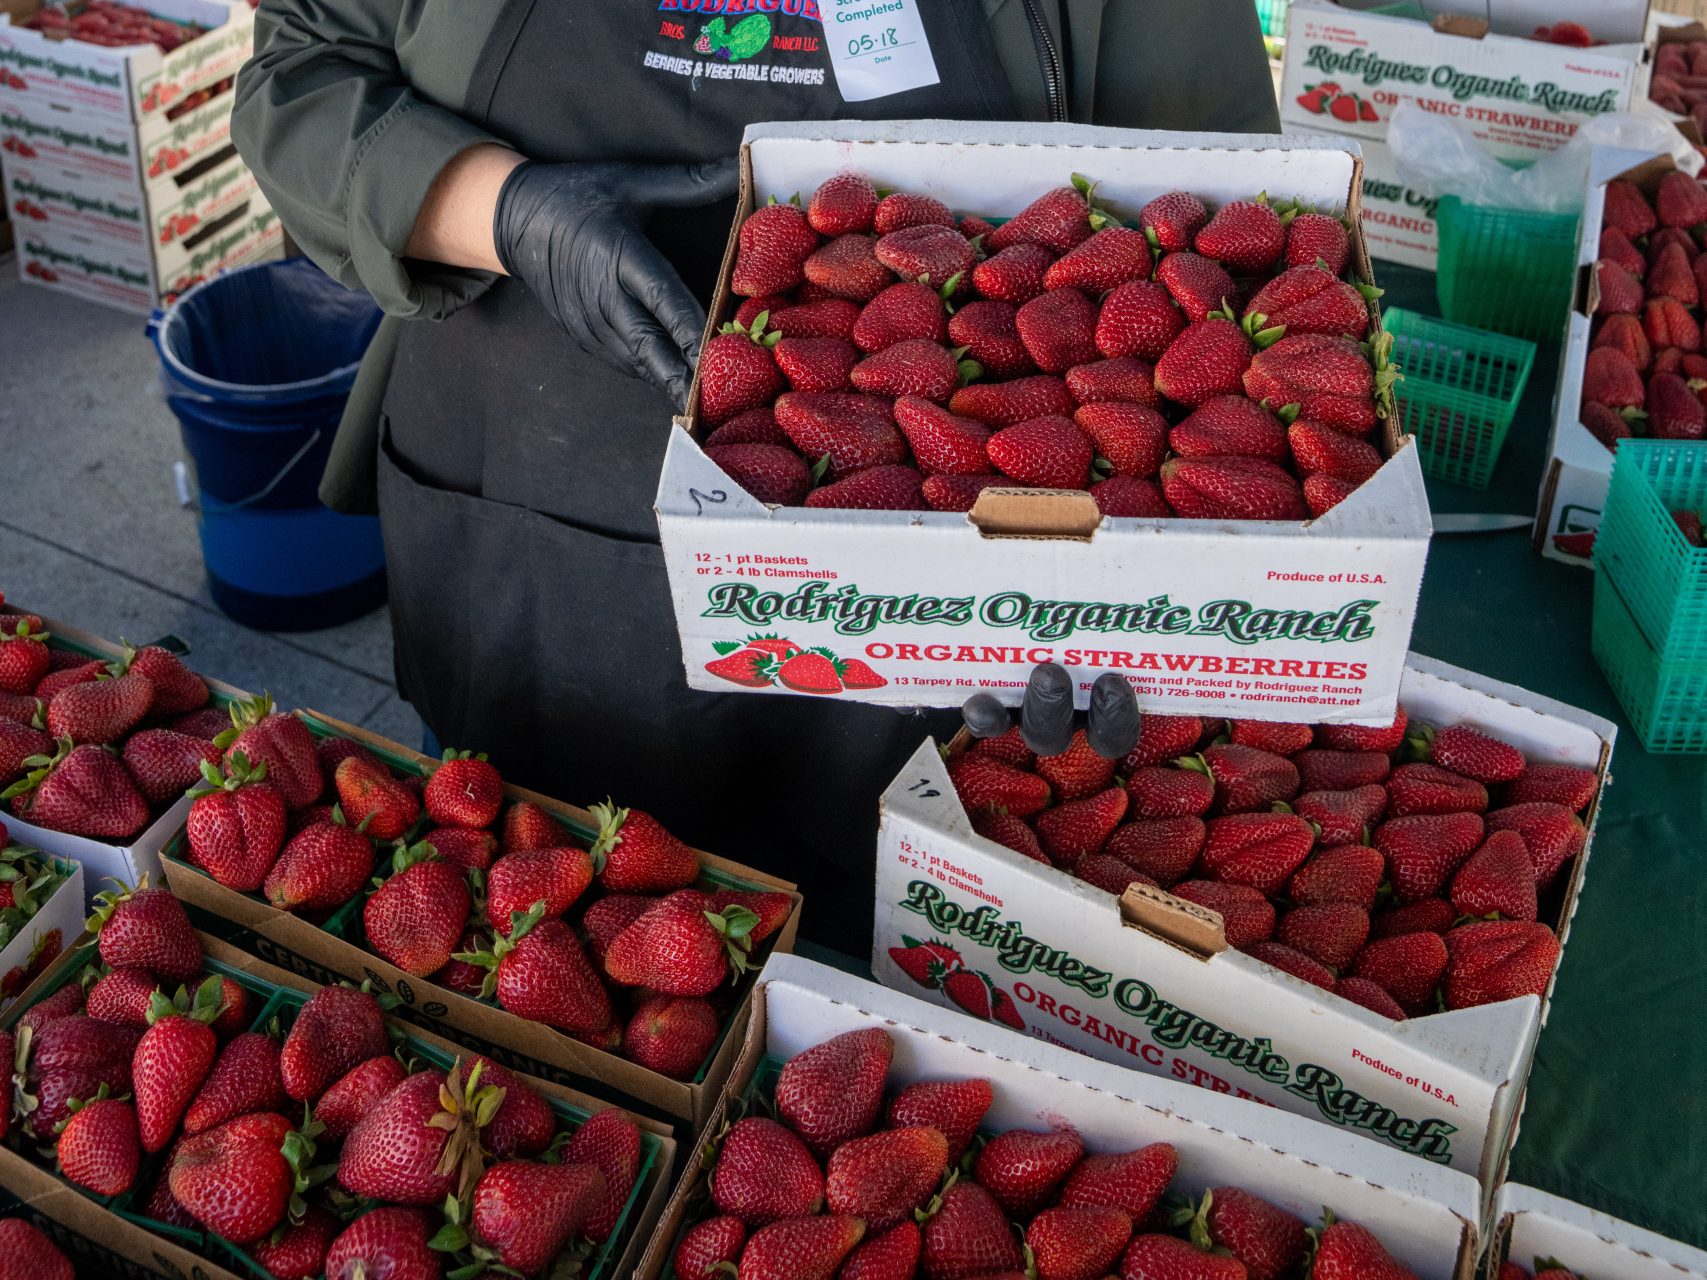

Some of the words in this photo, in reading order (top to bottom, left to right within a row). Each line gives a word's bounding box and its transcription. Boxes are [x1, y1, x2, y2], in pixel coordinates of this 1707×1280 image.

[772, 35, 801, 52] RANCH
[644, 50, 694, 76] BERRIES
[693, 62, 704, 78] &
[704, 61, 769, 82] VEGETABLE
[770, 65, 825, 85] GROWERS
[874, 54, 892, 64] Date
[1303, 43, 1432, 86] Rodriguez
[1431, 64, 1531, 102] Organic
[1532, 80, 1619, 116] Ranch
[1362, 208, 1433, 235] RGANIC
[695, 553, 711, 563] 12
[725, 554, 731, 563] 1
[737, 554, 751, 565] pt
[754, 554, 808, 566] Baskets
[696, 567, 711, 576] or
[714, 566, 723, 576] 2
[736, 567, 745, 576] 4
[749, 567, 761, 577] lb
[764, 567, 838, 579] Clamshells
[1267, 570, 1325, 584] Produce
[1328, 572, 1344, 584] of
[1346, 572, 1387, 585] U.S.A.
[700, 580, 976, 636] Rodriguez
[979, 593, 1191, 642] Organic
[1187, 598, 1380, 646] Ranch
[865, 642, 1054, 666] ORGANIC
[1064, 648, 1368, 680] STRAWBERRIES
[894, 676, 909, 686] 13
[912, 677, 952, 688] Tarpey
[956, 678, 976, 687] Rd.
[979, 679, 1028, 688] Watsonv
[1117, 674, 1156, 684] rown
[1159, 675, 1183, 686] and
[1186, 677, 1232, 689] Packed
[1235, 679, 1252, 691] by
[1254, 680, 1319, 694] Rodriguez
[1322, 684, 1363, 695] Ranch
[1167, 687, 1226, 700] 726-9008
[1240, 692, 1361, 706] rodriranch@att.net
[900, 841, 912, 853] 12
[921, 851, 927, 860] 1
[930, 856, 941, 867] pt
[943, 860, 984, 886] Baskets
[898, 854, 909, 864] or
[911, 859, 918, 869] 2
[927, 867, 934, 876] 4
[936, 871, 946, 881] lb
[948, 875, 1004, 908] Clamshells
[898, 879, 1113, 999] Rodriguez
[1113, 978, 1290, 1084] Organic
[1286, 1063, 1459, 1165] Ranch
[1013, 982, 1164, 1067] ORGANIC
[1031, 1025, 1043, 1037] 13
[1351, 1048, 1403, 1081] Produce
[1406, 1075, 1420, 1089] of
[1421, 1082, 1459, 1108] U.S.A.
